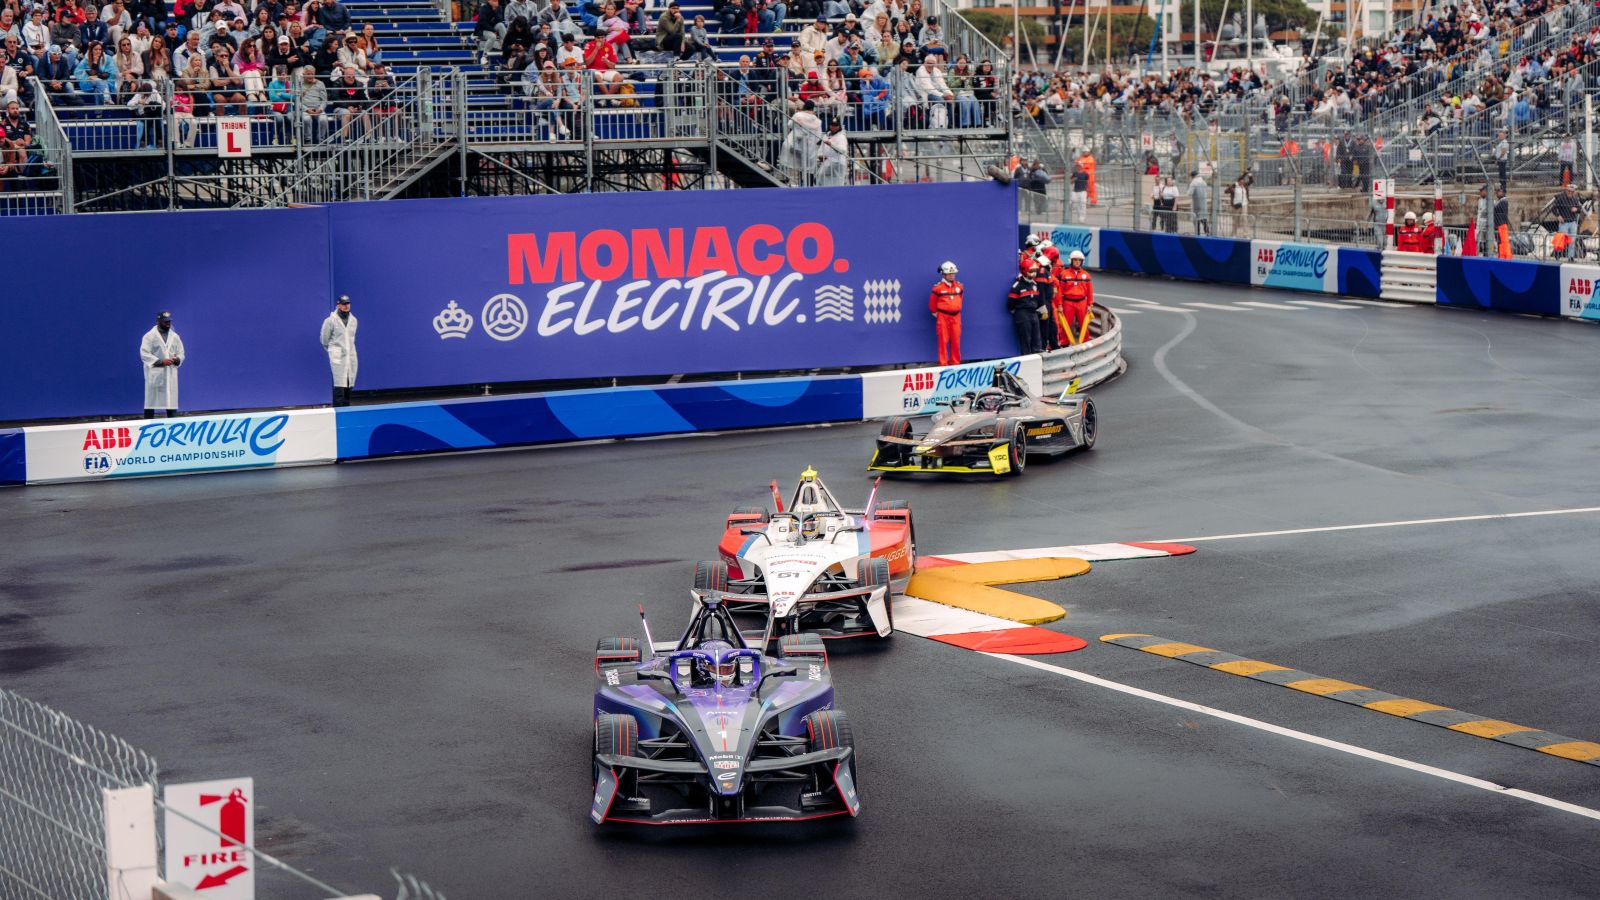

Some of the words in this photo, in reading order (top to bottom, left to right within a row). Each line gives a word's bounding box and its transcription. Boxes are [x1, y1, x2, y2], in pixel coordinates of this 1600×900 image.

[221, 122, 247, 130] TRIBUNE
[227, 132, 242, 153] L
[507, 222, 849, 284] MONACO.
[1257, 248, 1274, 263] ABB
[1275, 248, 1316, 269] FORMULA
[1569, 278, 1591, 295] ABB
[537, 270, 807, 337] ELECTRIC.
[902, 372, 935, 392] ABB
[82, 427, 132, 451] ABB
[135, 417, 252, 451] FORMULA
[116, 455, 156, 466] WORLD
[160, 449, 246, 463] CHAMPIONSHIP
[183, 850, 247, 867] FIRE
